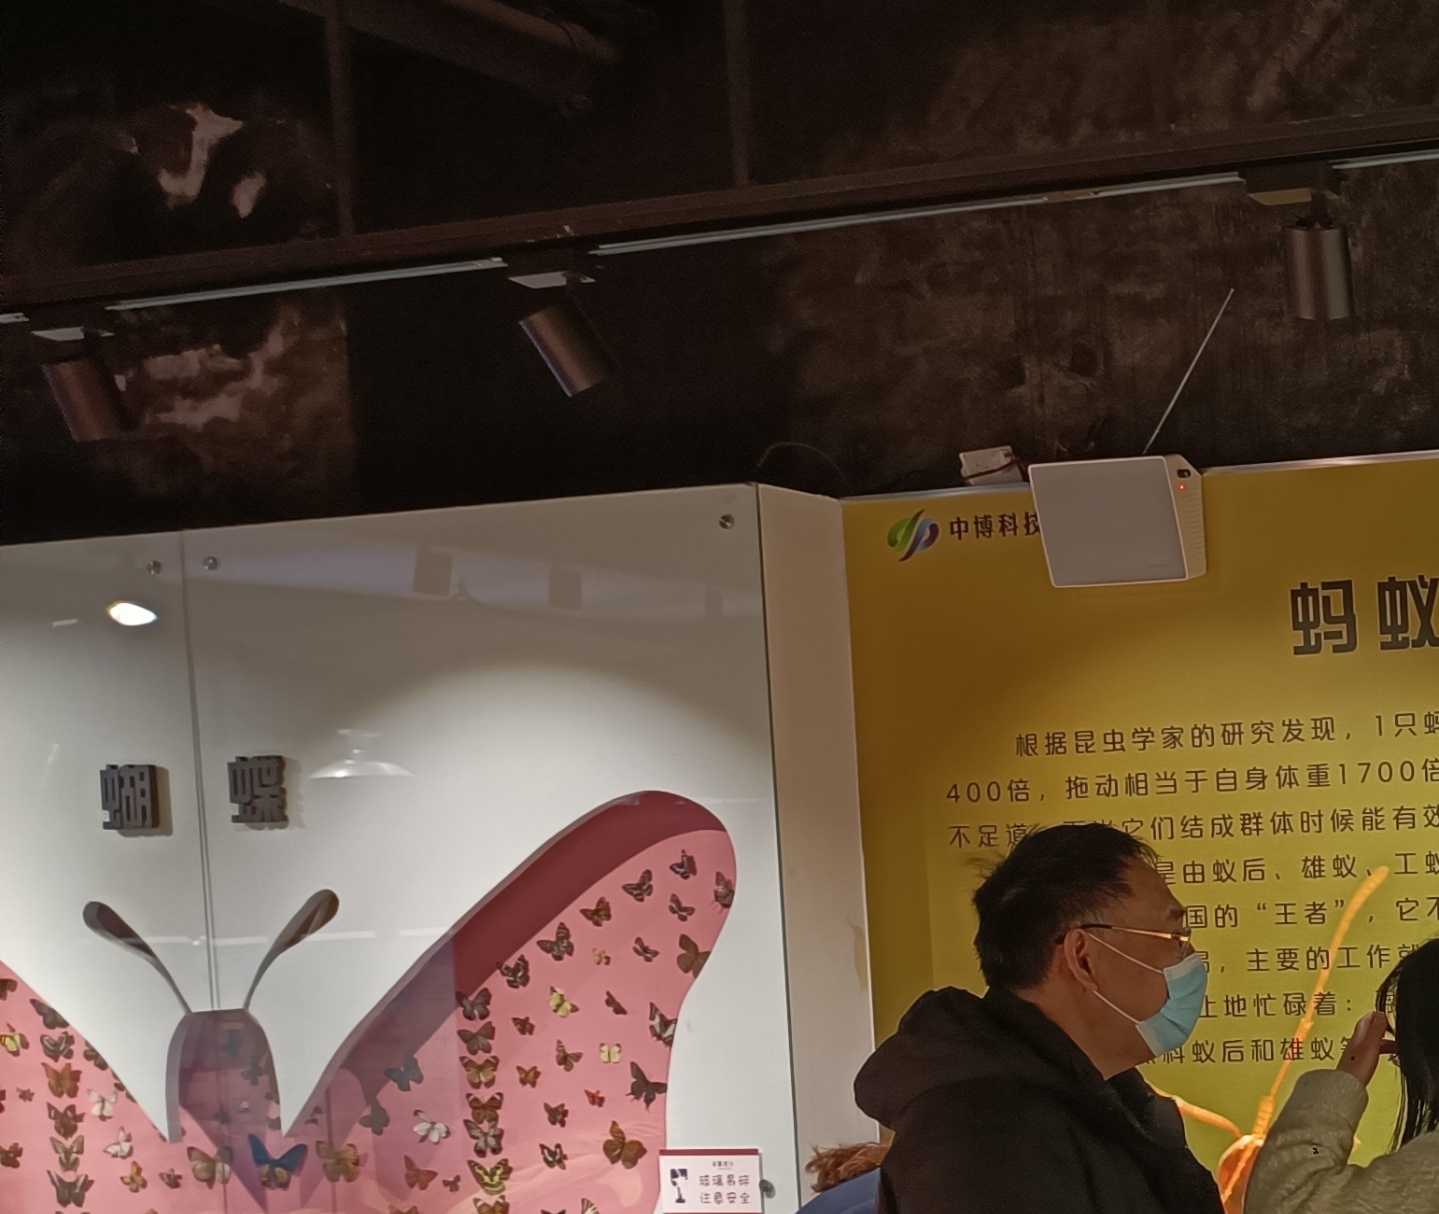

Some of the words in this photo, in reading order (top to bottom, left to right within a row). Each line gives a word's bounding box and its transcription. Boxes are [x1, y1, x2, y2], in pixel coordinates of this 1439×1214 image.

[949, 511, 1041, 540] 中博科技
[100, 755, 288, 830] 蝴蝶
